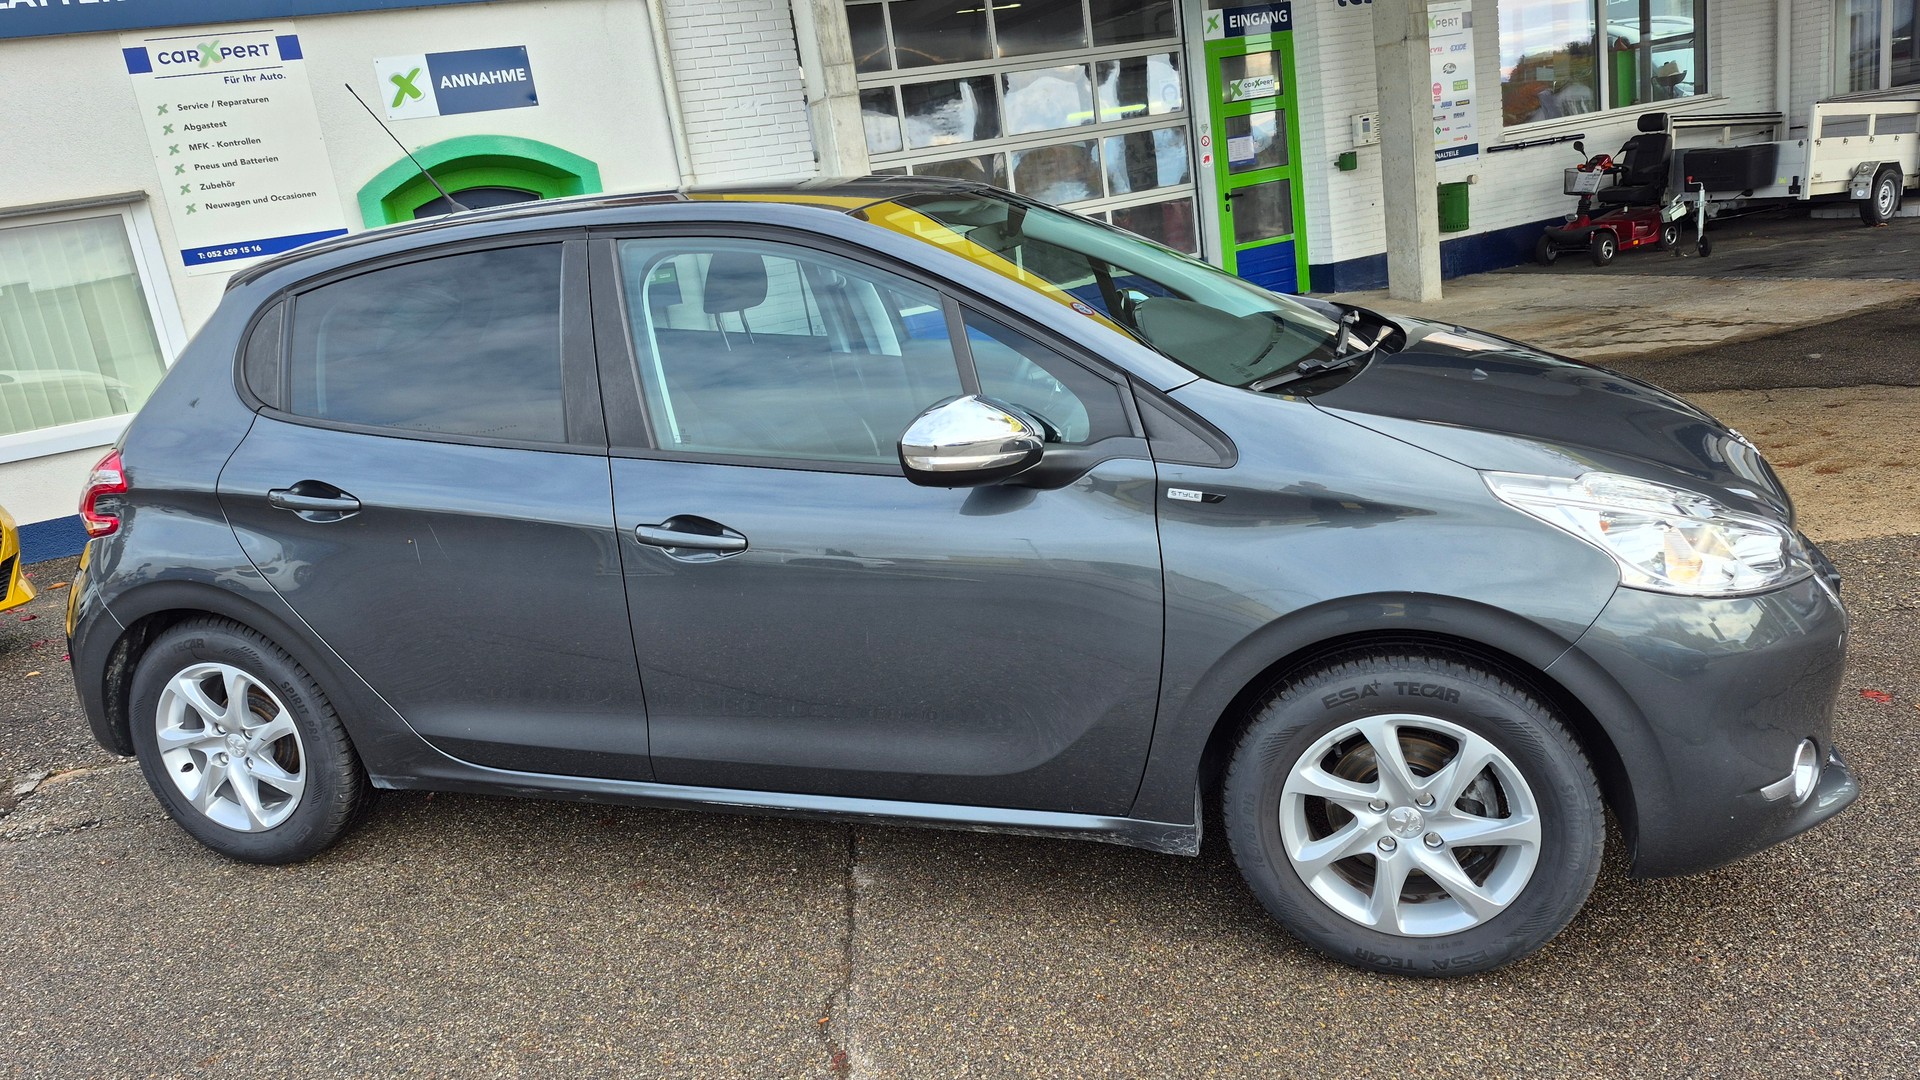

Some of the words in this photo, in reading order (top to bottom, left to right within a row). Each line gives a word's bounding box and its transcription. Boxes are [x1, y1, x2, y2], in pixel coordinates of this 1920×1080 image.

[1229, 10, 1288, 28] EINGANG
[223, 75, 240, 85] Für
[243, 73, 257, 83] Ihr
[259, 72, 287, 82] Auto.
[440, 68, 527, 89] ANNAHME
[177, 102, 209, 112] Service
[217, 96, 270, 108] Reparaturen
[183, 120, 227, 132] Abgastest
[188, 143, 210, 152] MFK
[217, 137, 262, 148] Kontrollen
[194, 162, 221, 172] Pneus
[222, 159, 239, 168] und
[240, 155, 279, 166] Batterien
[199, 180, 236, 191] Zubehör
[205, 199, 251, 210] Neuwagen
[252, 196, 269, 205] und
[270, 190, 317, 202] Occasionen
[197, 252, 205, 260] T:
[206, 250, 222, 259] 052
[223, 248, 238, 257] 659
[240, 246, 250, 254] 15
[251, 244, 262, 253] 16
[1170, 490, 1200, 499] STYLE
[170, 638, 205, 653] TECAR
[1393, 681, 1461, 704] TECAR
[280, 681, 310, 722] SPIRIT
[306, 719, 321, 742] PRO
[1353, 946, 1417, 971] TECAR
